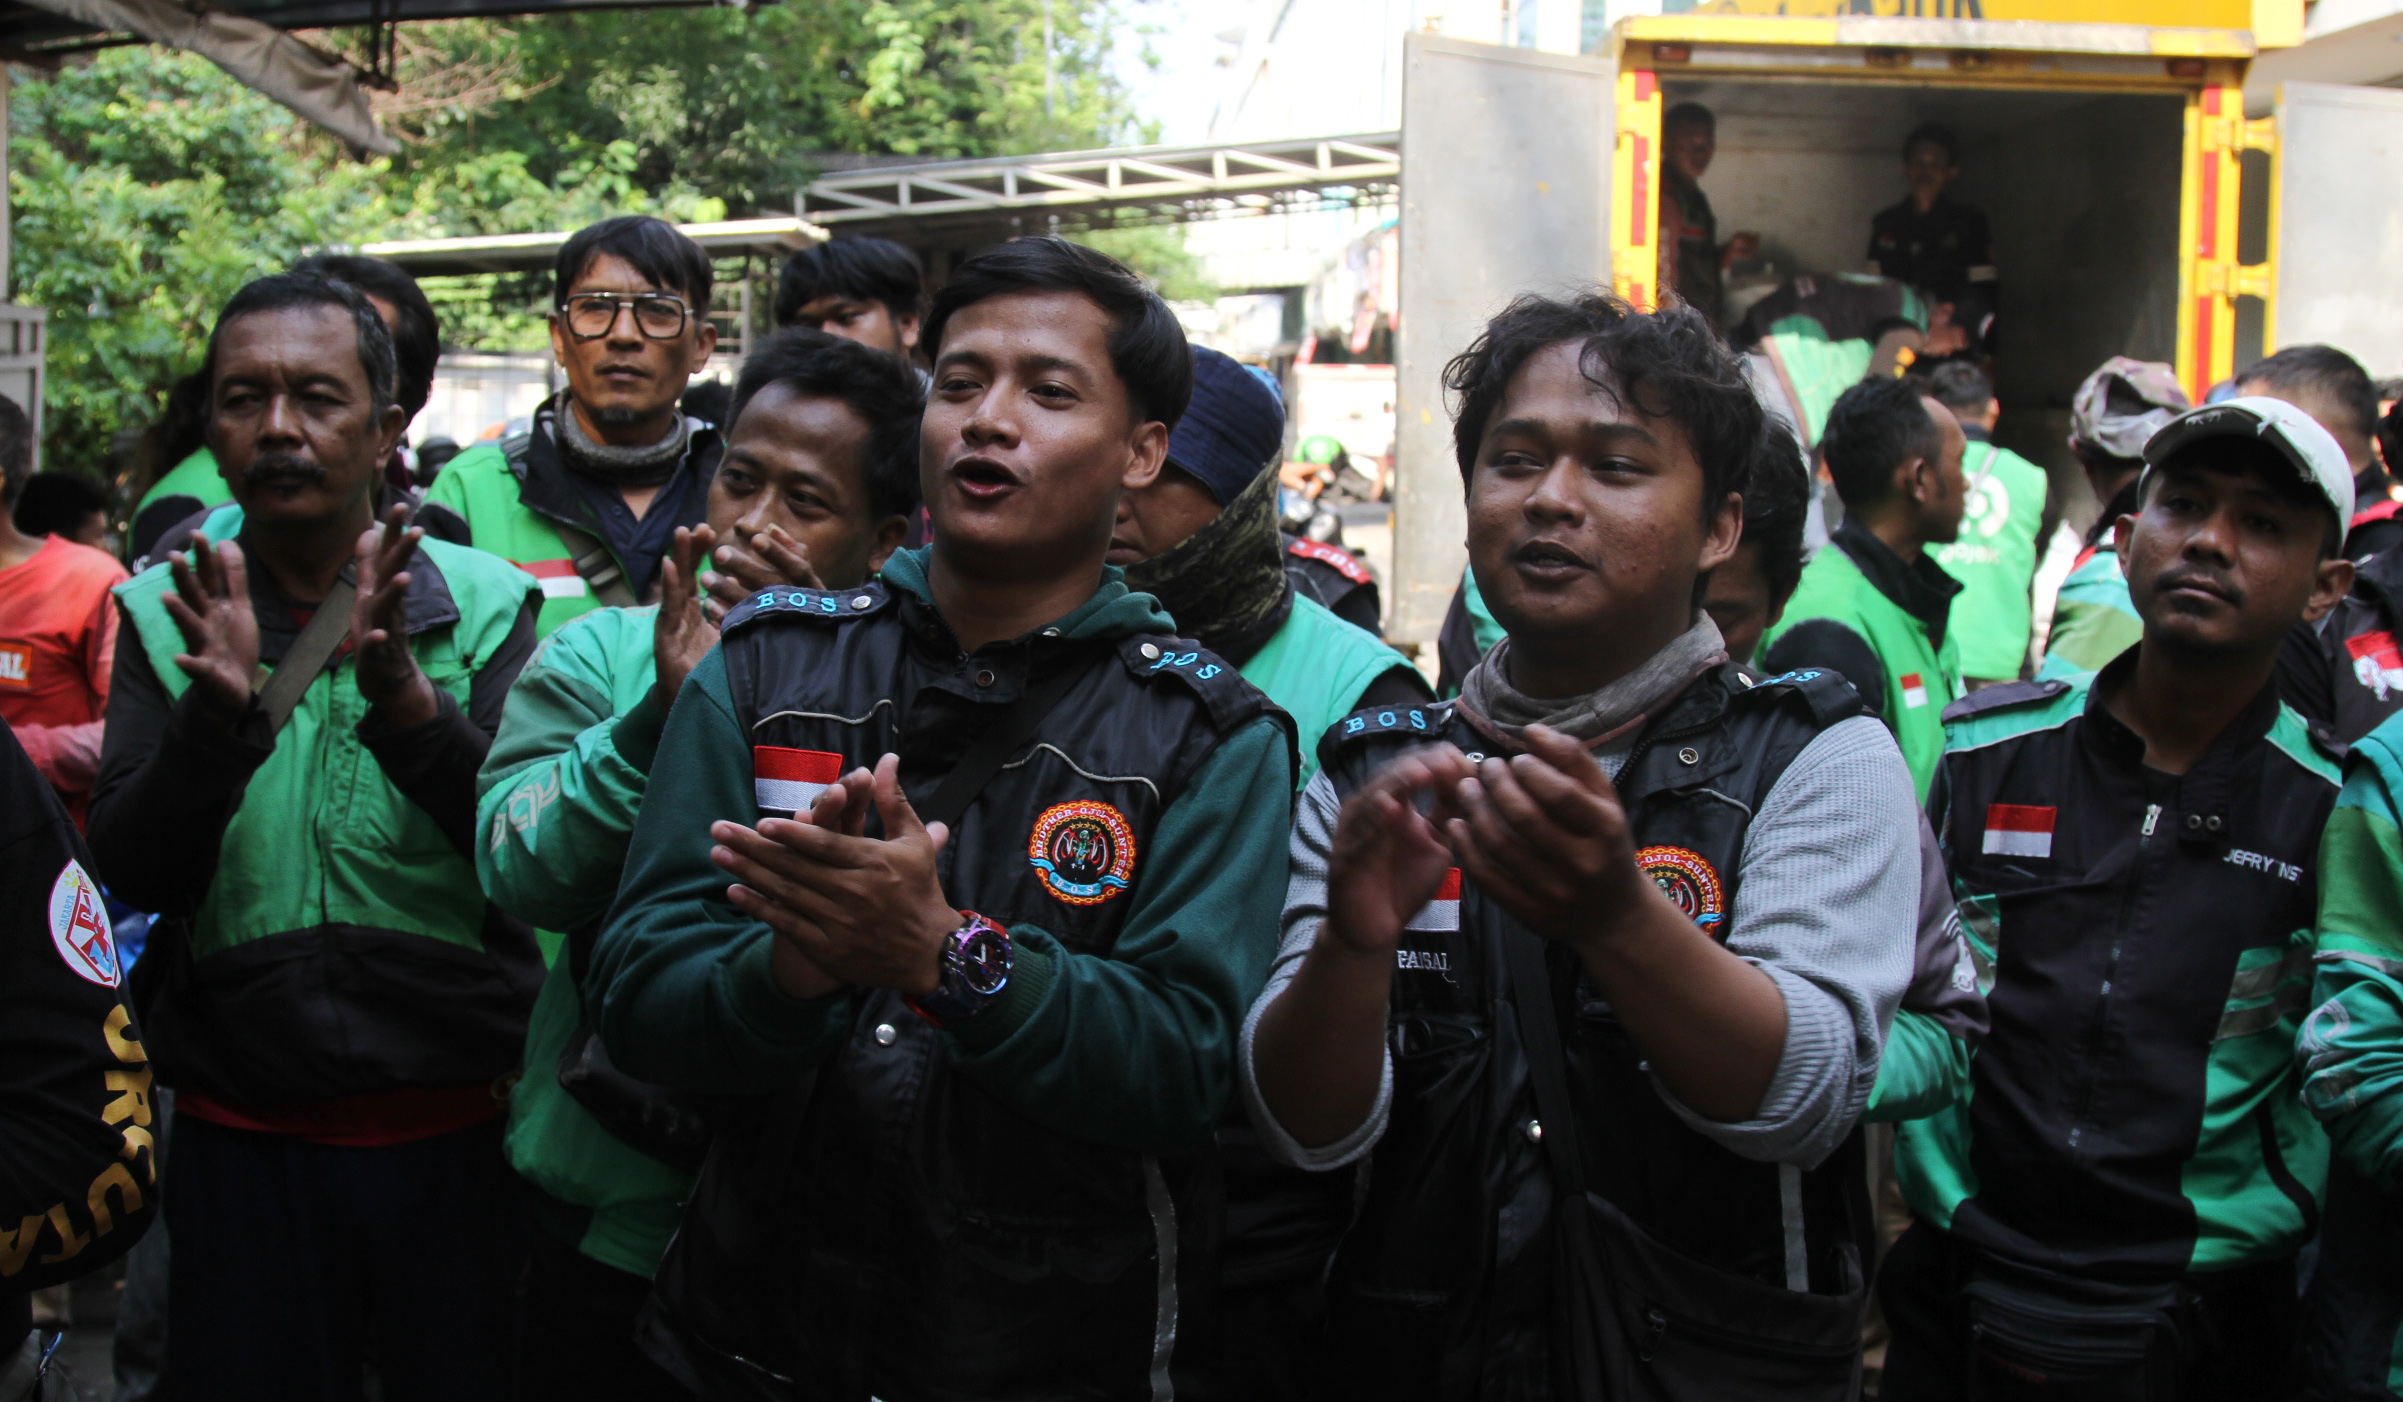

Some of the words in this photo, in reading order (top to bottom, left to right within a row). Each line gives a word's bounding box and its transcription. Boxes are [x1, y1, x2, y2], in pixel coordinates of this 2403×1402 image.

[756, 592, 838, 612] BOS
[1150, 651, 1222, 680] BOS
[1345, 709, 1427, 734] BOS
[59, 895, 76, 930] JAKARTA
[1397, 950, 1452, 971] FAISAL
